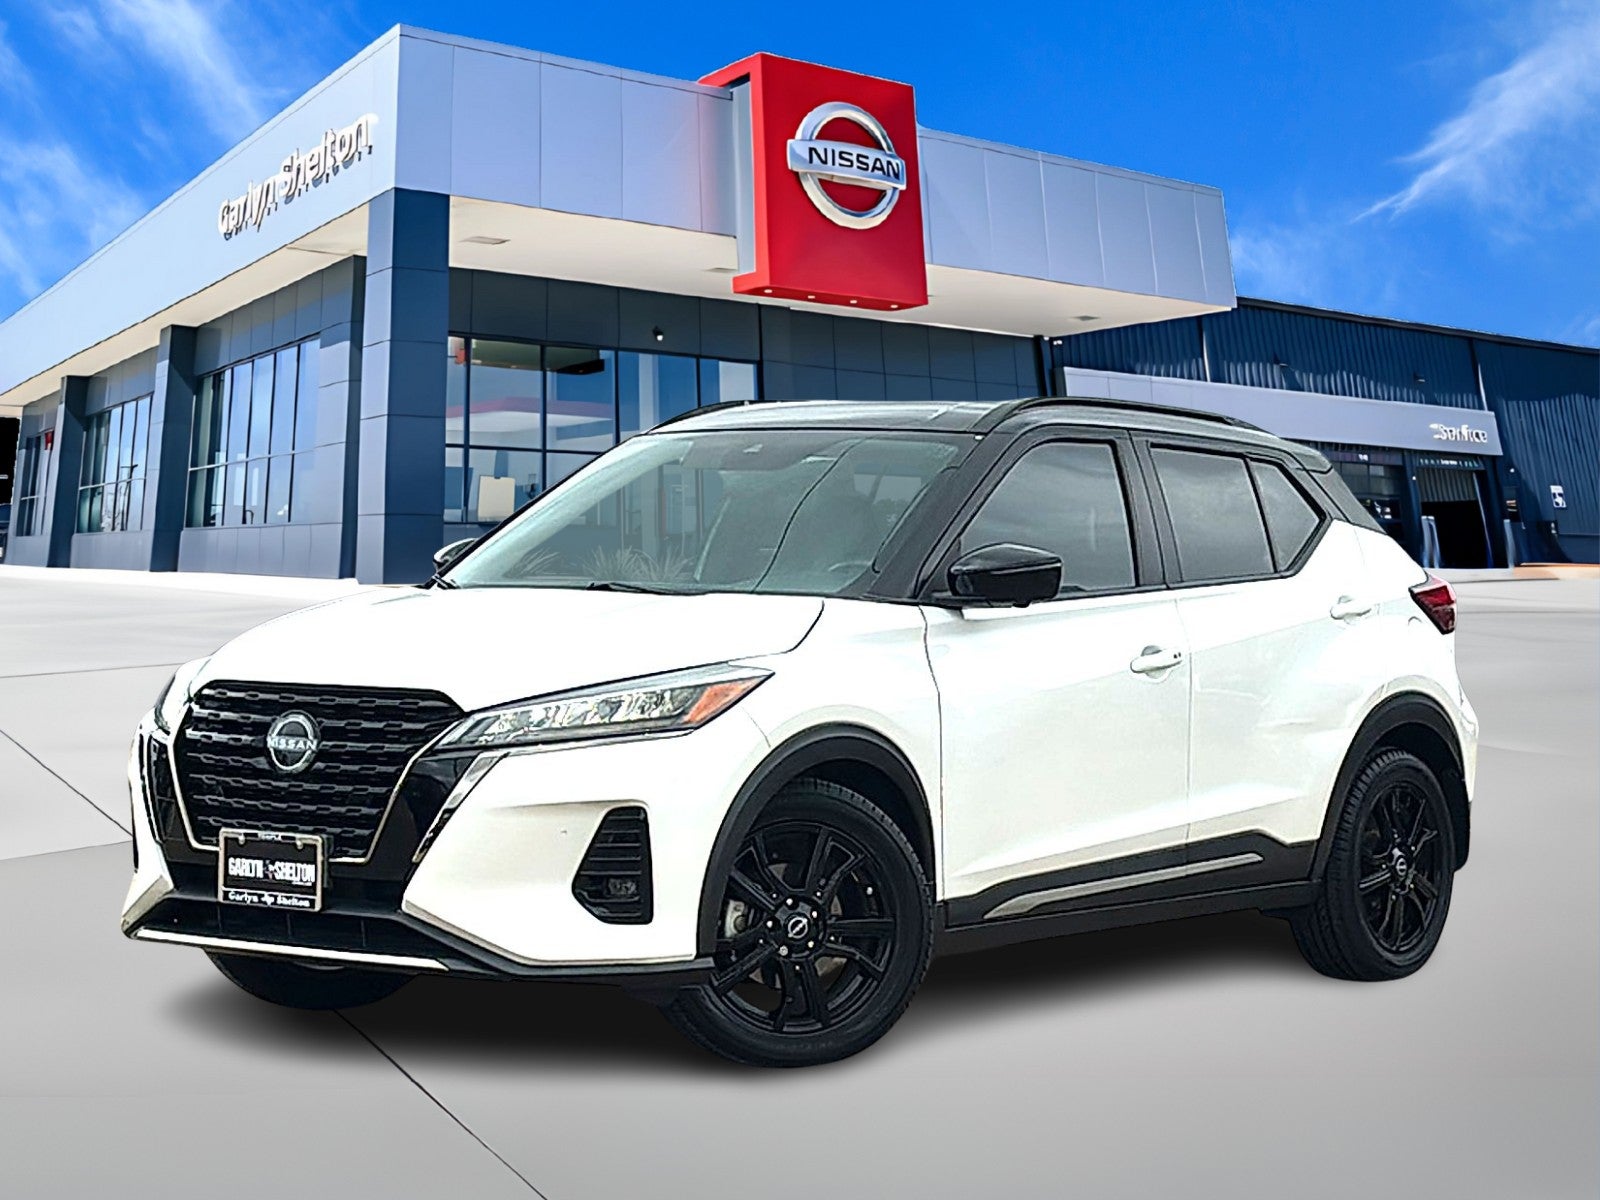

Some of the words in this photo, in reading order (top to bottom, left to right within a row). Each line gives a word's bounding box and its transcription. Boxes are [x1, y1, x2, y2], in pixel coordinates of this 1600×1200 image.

[278, 116, 376, 204] Shelton
[808, 146, 900, 180] NISSAN
[267, 736, 318, 751] NISSAN
[274, 861, 316, 883] SHELTON
